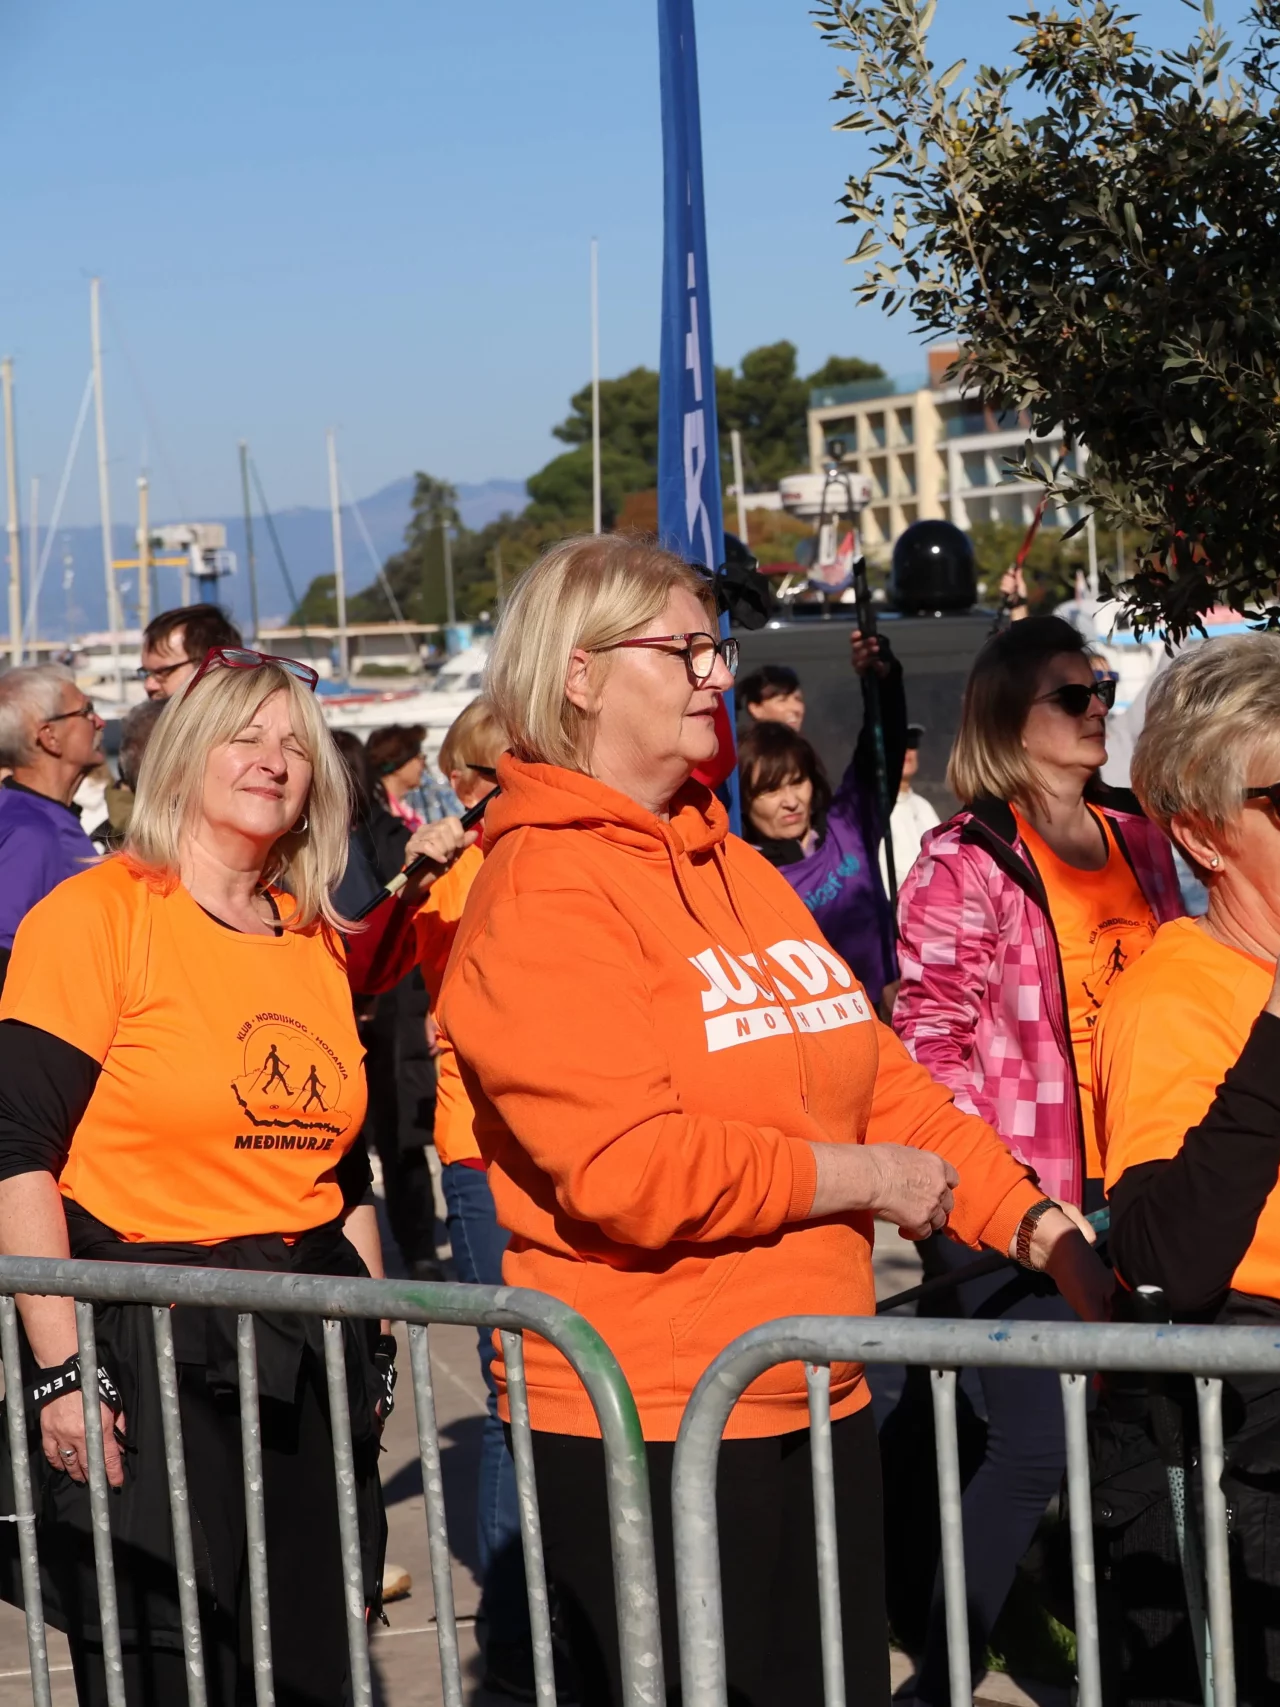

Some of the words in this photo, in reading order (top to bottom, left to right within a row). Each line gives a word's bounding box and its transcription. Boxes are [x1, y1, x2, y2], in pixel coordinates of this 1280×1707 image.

[804, 871, 842, 911] icef
[735, 998, 864, 1037] NOHING
[236, 1021, 253, 1042] KLUB
[255, 1012, 308, 1033] NORDIJSKOG
[315, 1036, 349, 1080] HODANJA
[234, 1135, 335, 1151] MEĐIMURJE
[33, 1370, 76, 1400] LEKI
